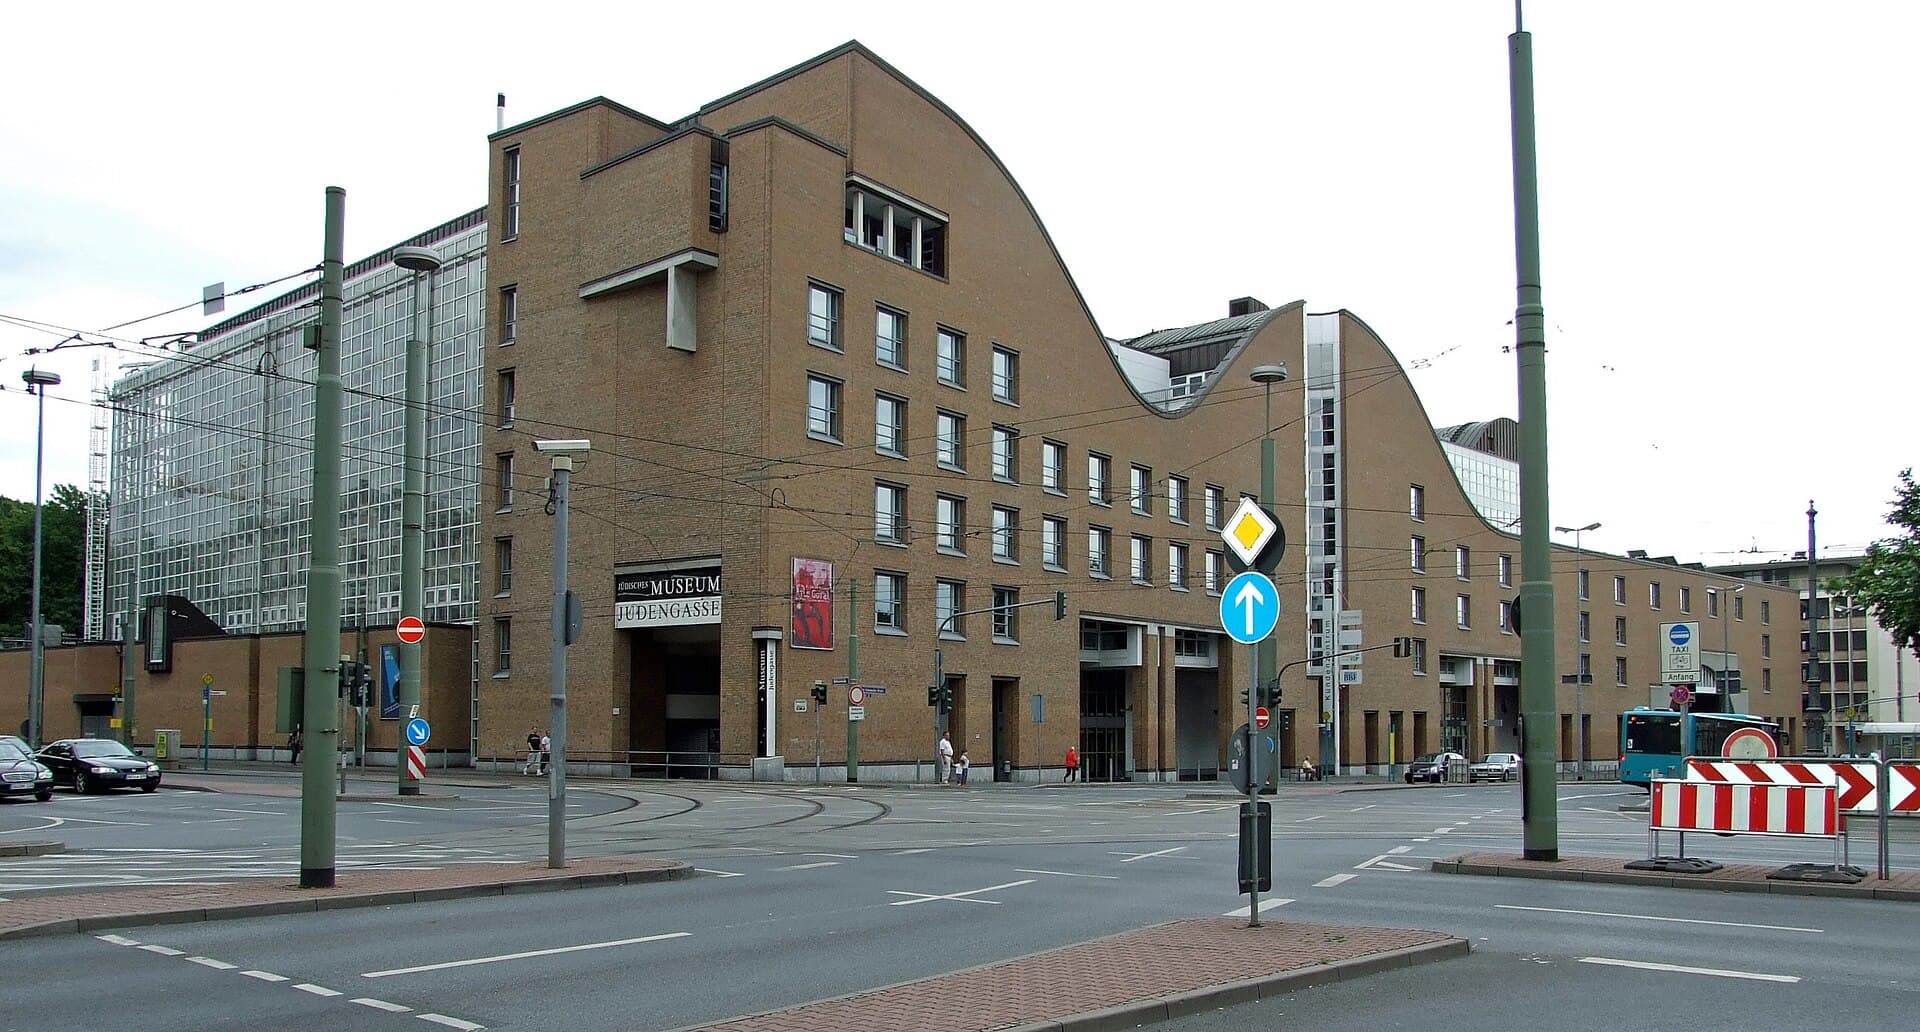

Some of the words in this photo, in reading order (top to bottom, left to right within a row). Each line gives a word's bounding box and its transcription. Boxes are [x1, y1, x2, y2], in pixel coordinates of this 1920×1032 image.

[618, 581, 649, 591] JÜDISCHES
[650, 576, 720, 596] MUSEUM
[617, 601, 720, 622] JUDENGASSE
[1667, 673, 1694, 682] Anfang
